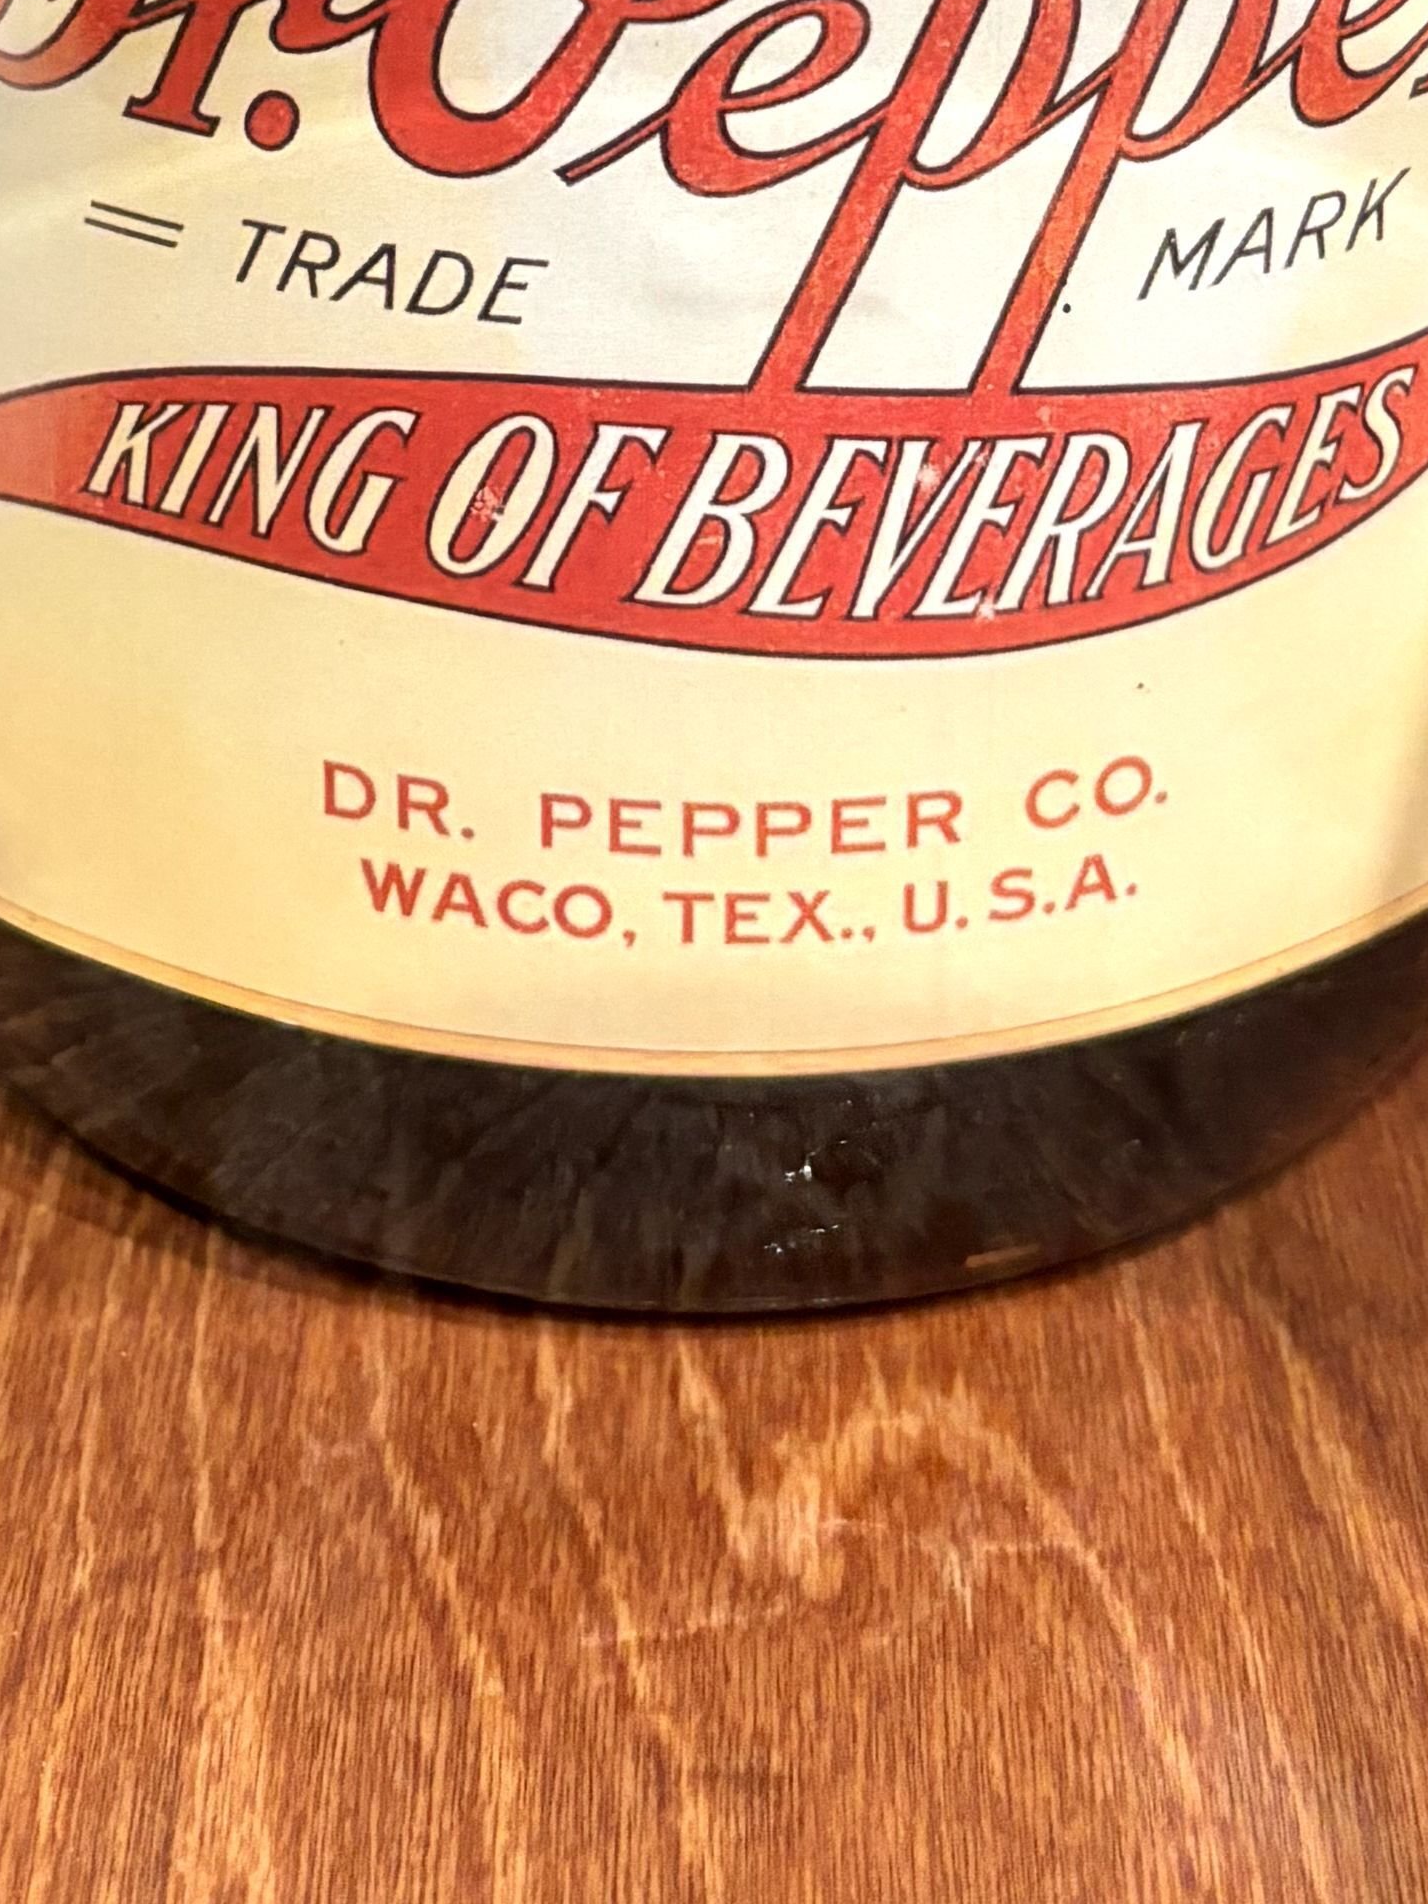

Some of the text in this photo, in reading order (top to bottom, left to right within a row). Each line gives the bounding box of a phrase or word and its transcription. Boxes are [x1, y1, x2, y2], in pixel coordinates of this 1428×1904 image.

[234, 165, 1412, 327] TRADE MARK
[85, 363, 1420, 622] KING OF BEVERAGES
[322, 754, 1170, 859] DR. PEPPER CO.
[360, 857, 638, 949] WACO,
[662, 887, 878, 947] TEX.,
